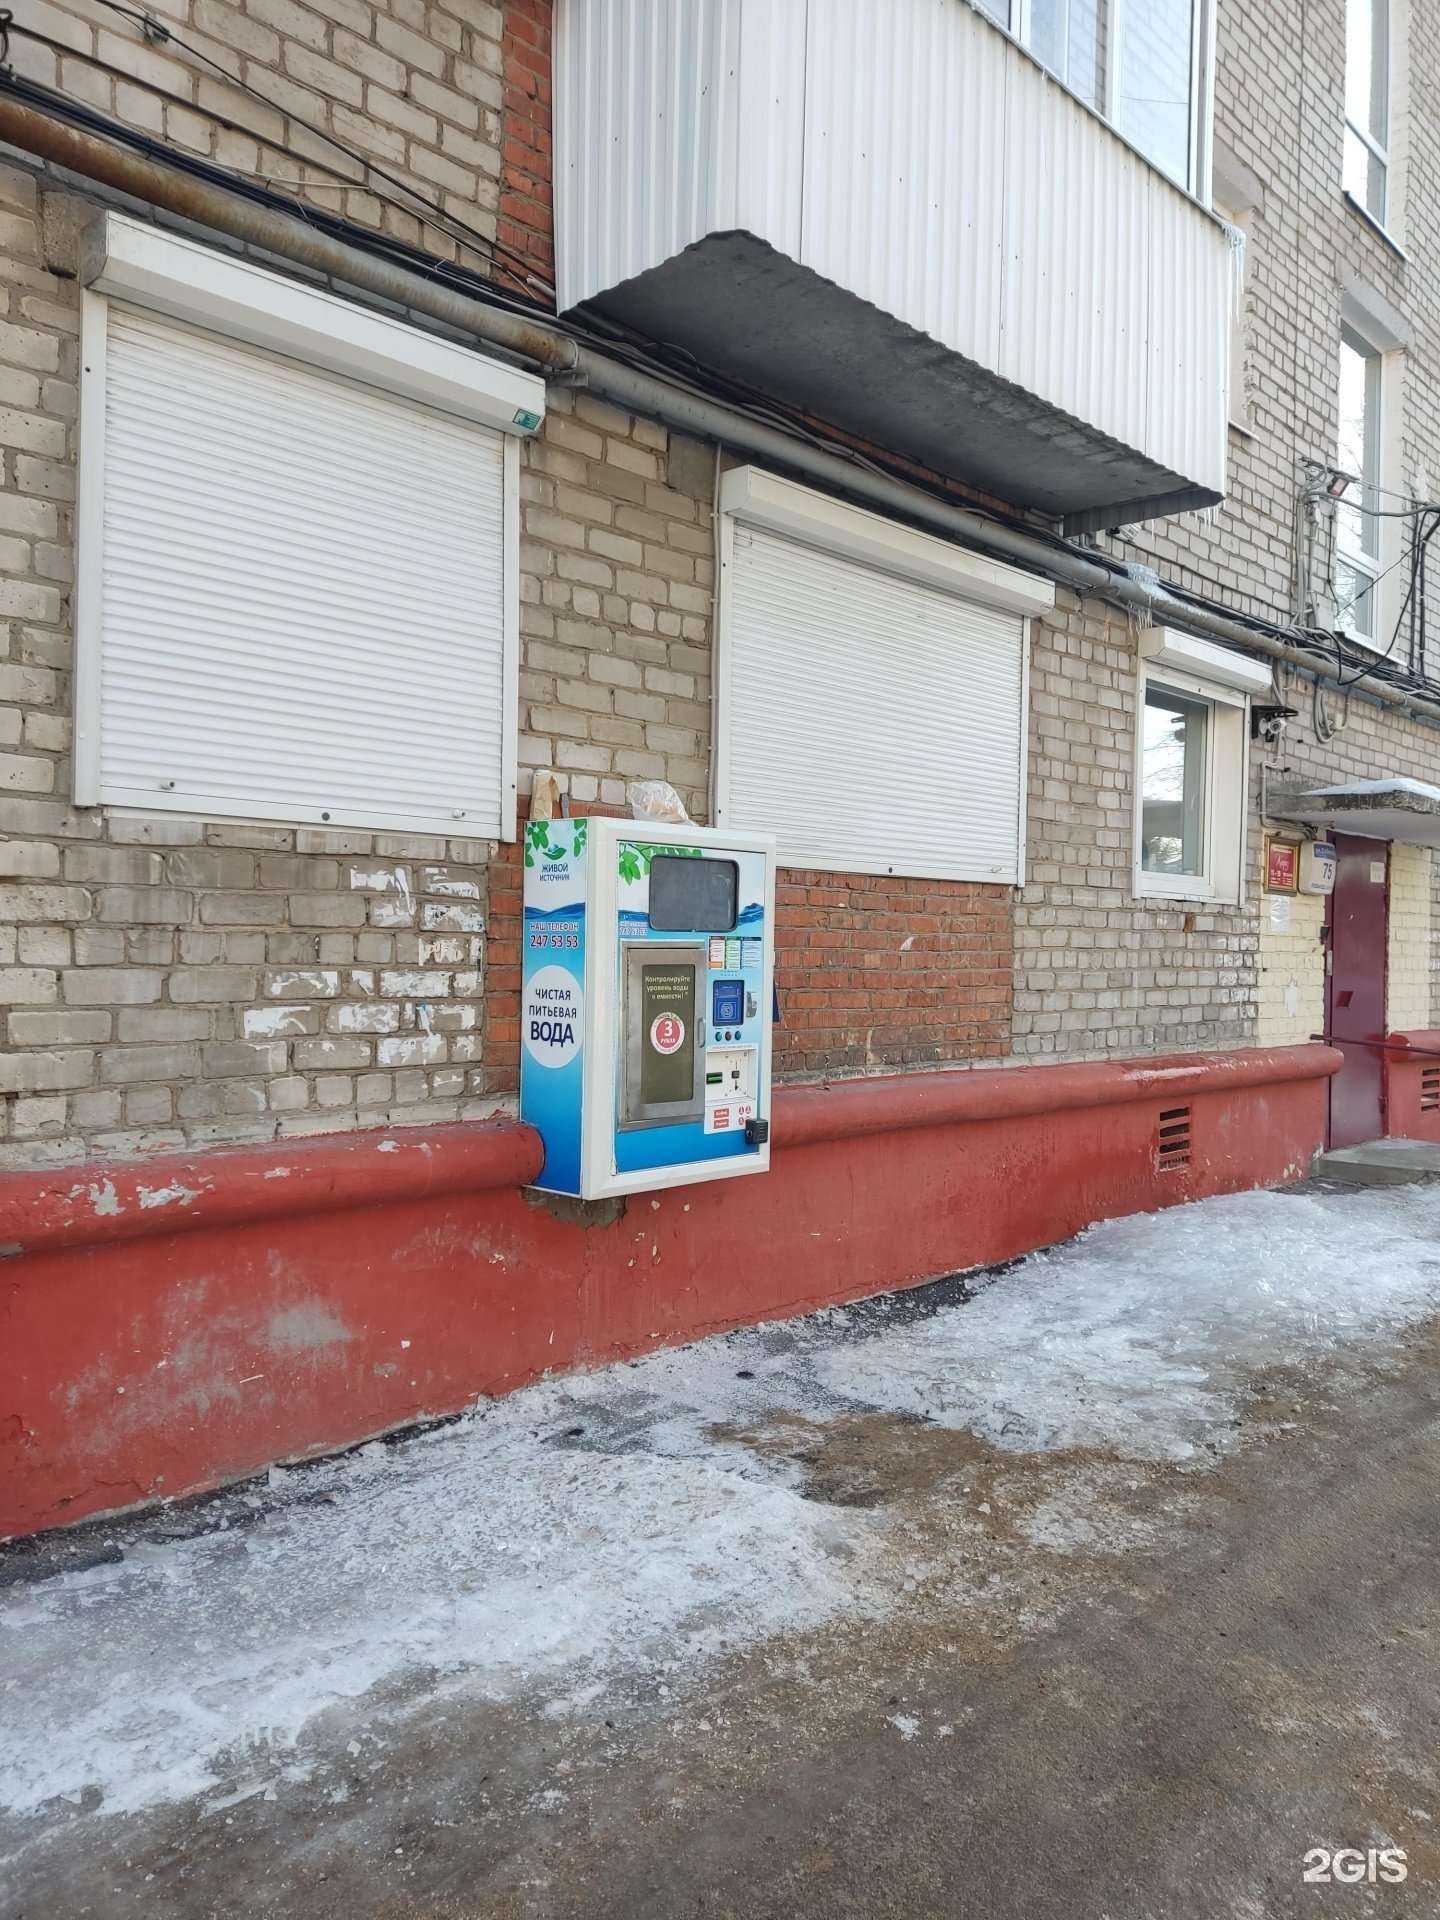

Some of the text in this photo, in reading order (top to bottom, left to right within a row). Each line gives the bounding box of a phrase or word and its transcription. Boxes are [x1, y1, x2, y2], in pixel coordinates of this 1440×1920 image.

[541, 863, 568, 873] ЖИВОЙ
[1322, 862, 1333, 881] 75
[539, 873, 570, 882] ИСТОЧНИК
[530, 922, 579, 932] НАШ ТЕЛЕФОН
[530, 935, 578, 948] 247 53 53
[535, 988, 571, 1001] ЧИСТАЯ
[528, 1005, 577, 1019] ПИТЬЕВАЯ
[530, 1021, 574, 1048] ВОДА
[663, 1021, 673, 1037] 3
